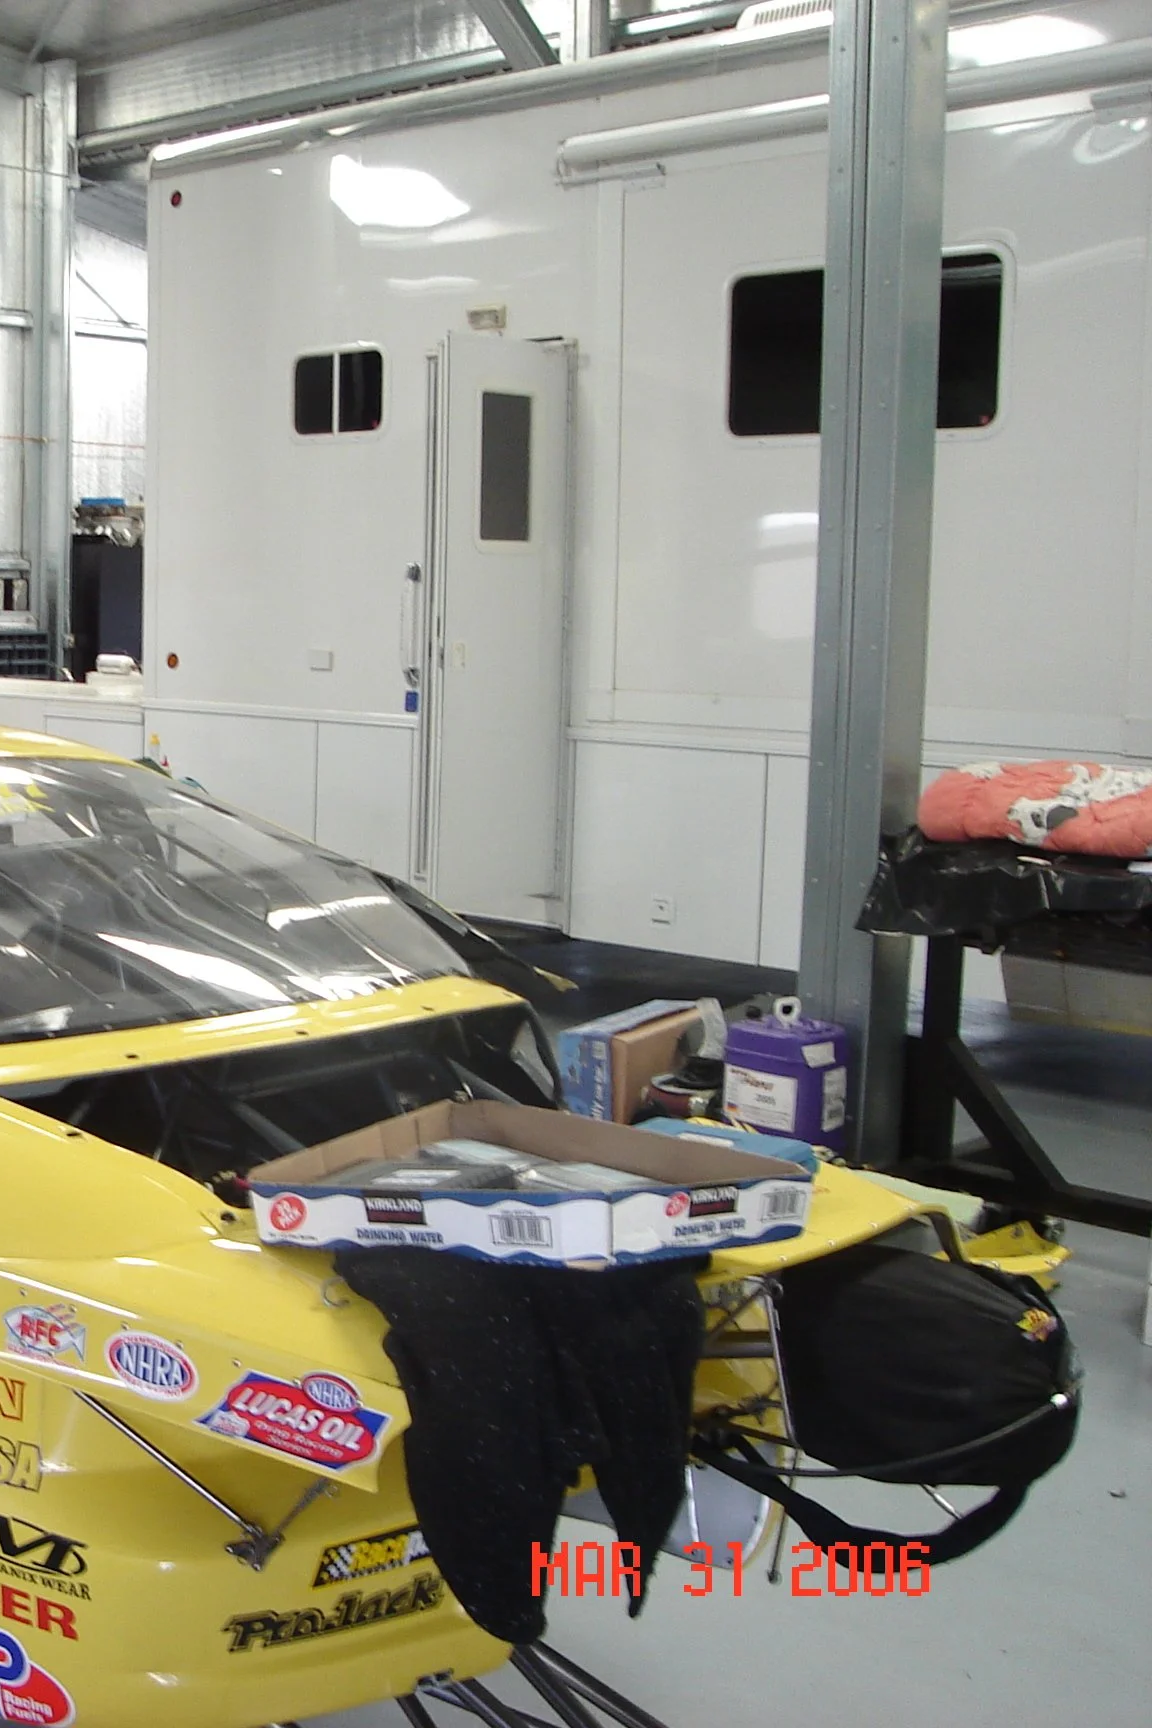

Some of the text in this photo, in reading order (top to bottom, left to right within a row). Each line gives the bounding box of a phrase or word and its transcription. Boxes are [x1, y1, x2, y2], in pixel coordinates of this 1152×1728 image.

[367, 1197, 423, 1213] KIRKLAND
[356, 1227, 444, 1244] DRINKING WATER
[118, 1344, 186, 1388] NHRA
[307, 1380, 354, 1409] NHRA
[232, 1387, 325, 1433] LUCAS
[319, 1417, 366, 1451] OIL
[38, 1577, 92, 1601] WEAR
[2, 1689, 53, 1718] Racing
[5, 1702, 45, 1723] Fuels
